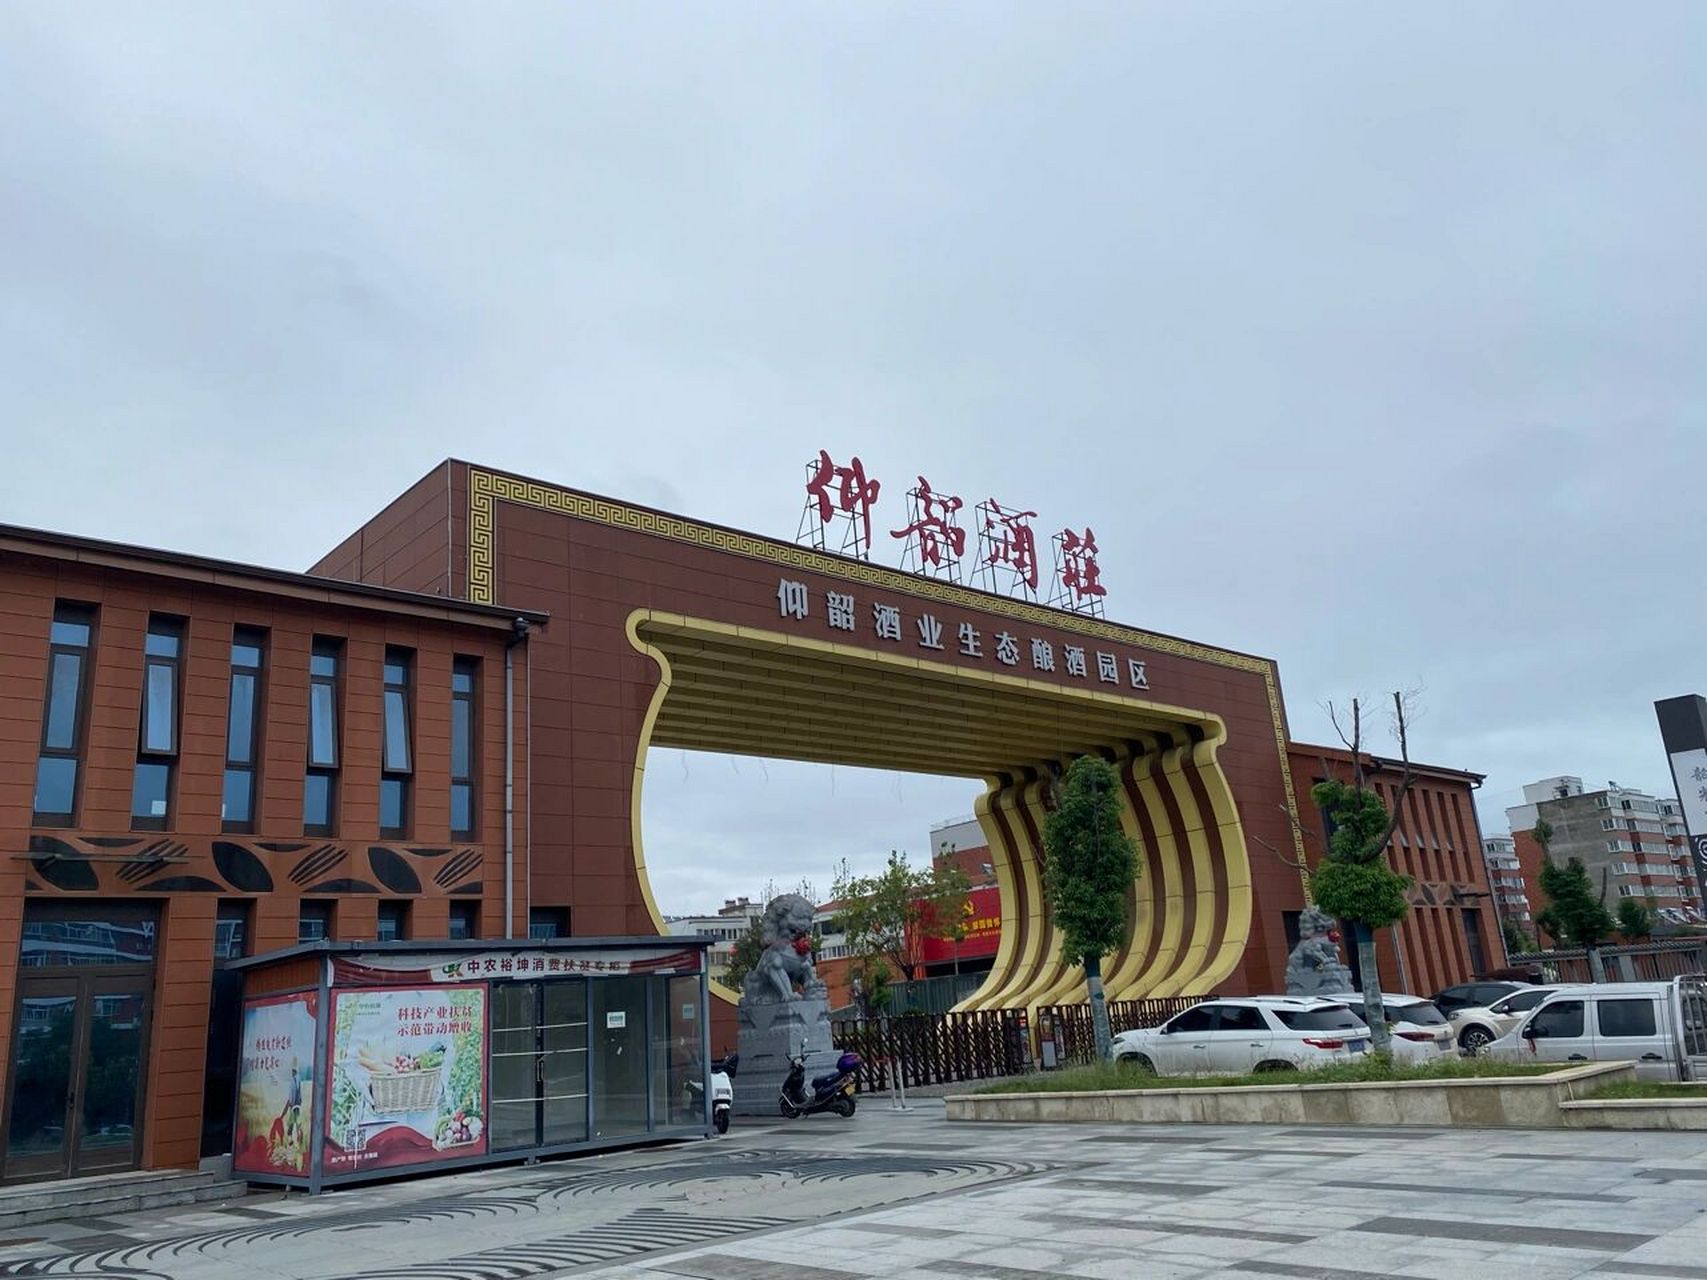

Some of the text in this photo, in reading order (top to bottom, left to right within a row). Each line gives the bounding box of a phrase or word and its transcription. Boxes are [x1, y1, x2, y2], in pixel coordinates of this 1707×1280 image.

[777, 578, 1150, 690] 仰韶酒业生态酿酒园区
[398, 1006, 472, 1020] 科技产业扶贫
[397, 1021, 472, 1037] 示范带动增收
